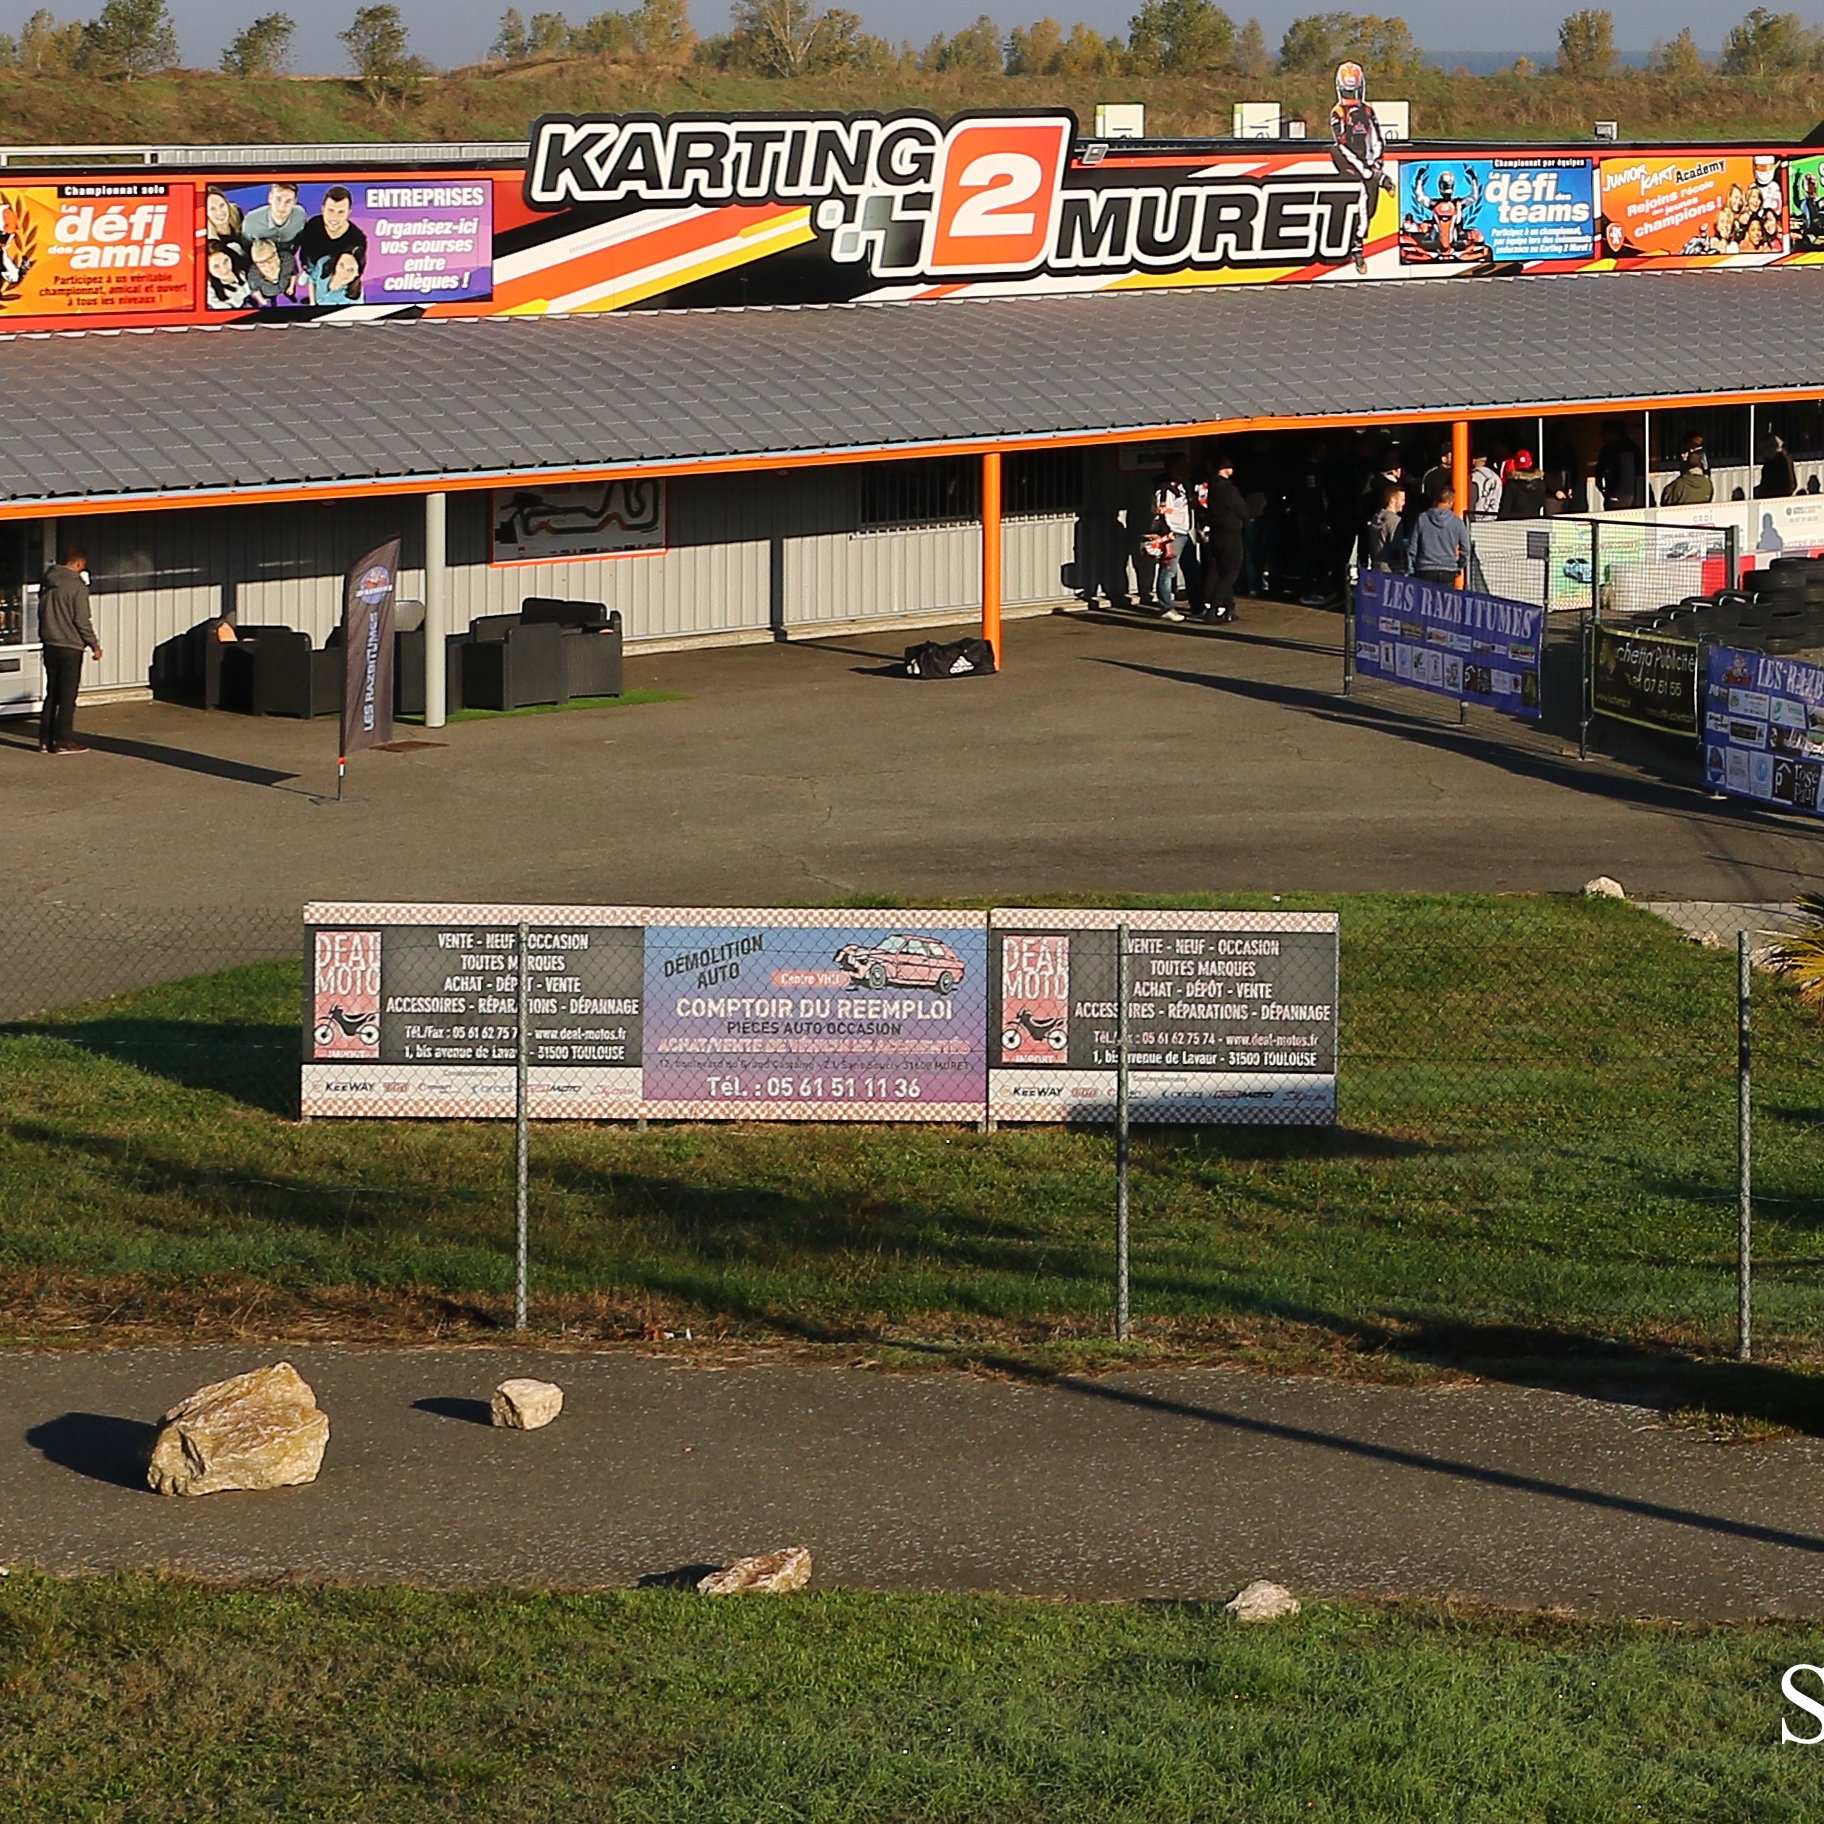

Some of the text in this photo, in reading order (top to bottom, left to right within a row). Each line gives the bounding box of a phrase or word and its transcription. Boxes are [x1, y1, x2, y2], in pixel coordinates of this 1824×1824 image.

[536, 125, 938, 196] KARTING
[1485, 172, 1559, 203] défi
[1603, 159, 1726, 196] JUNIOR KART Academy
[64, 185, 165, 197] Championnat solo
[366, 187, 484, 208] ENTREPRISES
[948, 152, 1043, 237] 2
[1498, 200, 1590, 224] teams
[1627, 191, 1678, 217] Rejoins
[1665, 196, 1699, 217] jeunes
[55, 205, 168, 243] défi
[375, 218, 479, 239] Organisez-ici
[1054, 189, 1362, 260] MURET
[1634, 201, 1715, 237] champions
[70, 239, 181, 269] amis
[380, 239, 473, 254] vos courses
[404, 256, 446, 272] entre
[384, 272, 459, 293] collègues
[1383, 578, 1533, 639] LES RAZBITUMES
[1655, 647, 1696, 673] Publicité
[363, 611, 379, 732] LES RAZBITUMES
[1757, 657, 1783, 690] LES
[1643, 678, 1656, 693] 07
[1794, 764, 1819, 786] rose
[1793, 785, 1815, 806] Paul
[315, 934, 381, 970] DEAL
[438, 933, 590, 950] VENTE NEUF OCCASION
[1127, 938, 1280, 956] VENTE NEUF OCCASION
[461, 954, 566, 972] TOUTES MRQUES
[664, 934, 764, 978] DÉMOLITION
[1003, 938, 1069, 975] DEAL
[697, 962, 740, 990] AUTO
[1150, 959, 1256, 977] TOUTES MARQUES
[315, 965, 380, 996] MOTO
[444, 973, 582, 993] ACHAT DÉPT VENTE
[780, 974, 815, 985] Centre
[1002, 971, 1069, 1000] MOTO
[1133, 979, 1273, 999] ACHAT DÉPÔT VENTE
[386, 995, 639, 1015] ACCESSOIRES DÉPANNAGE
[675, 997, 953, 1020] COMPTOIR DU REEMPLOI
[1168, 1000, 1331, 1021] RÉPARATIONS DÉPANNAGE
[452, 1026, 466, 1039] 05
[481, 1026, 495, 1039] 62
[783, 1021, 823, 1035] AUTO
[826, 1022, 902, 1036] OCCASION
[1142, 1031, 1155, 1044] 05
[1171, 1032, 1185, 1045] 62
[416, 1043, 626, 1060] bis avenue de 31500 TOULOUSE
[1165, 1051, 1318, 1067] de Lavaur 31500 TOULOUSE
[706, 1074, 922, 1098] Tél. 05 61 51 11 36
